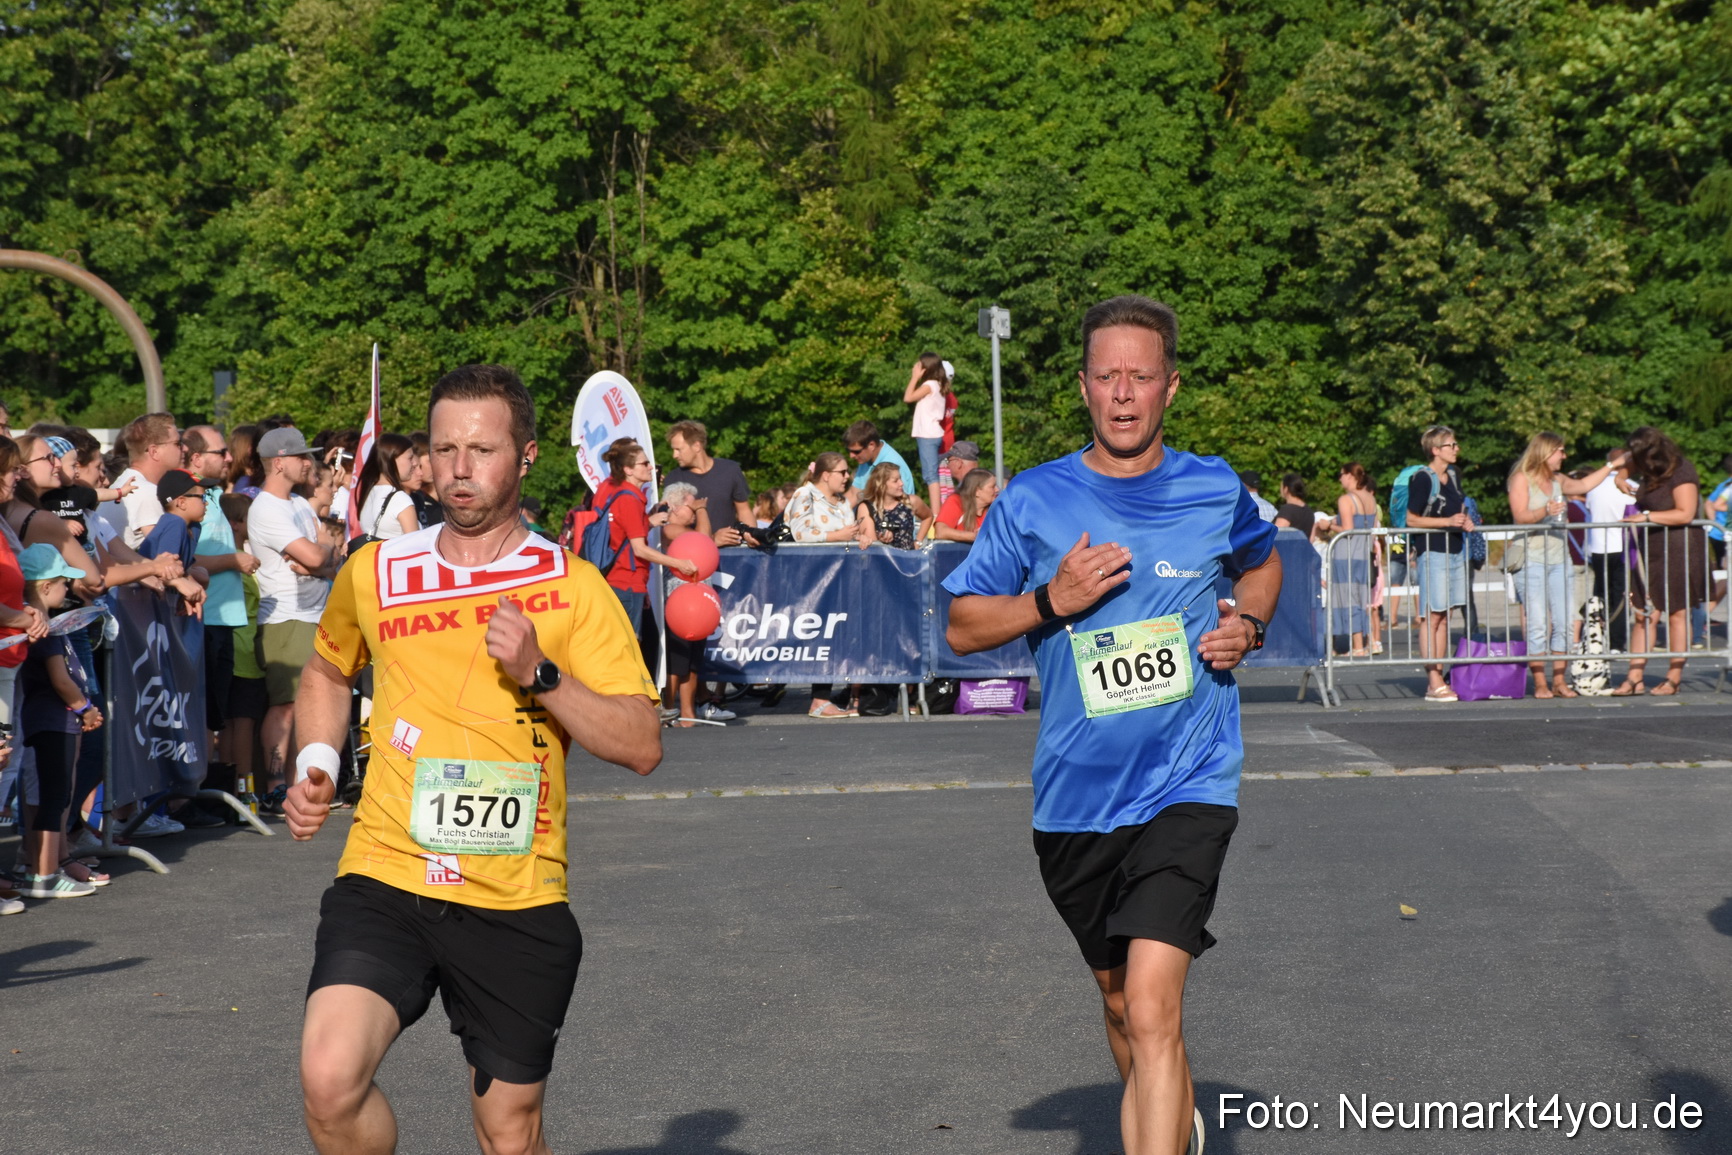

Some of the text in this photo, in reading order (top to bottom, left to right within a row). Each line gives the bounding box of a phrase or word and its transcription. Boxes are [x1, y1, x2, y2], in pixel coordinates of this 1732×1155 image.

[378, 609, 463, 643] MAX
[704, 646, 831, 662] TOMOBILE
[1089, 640, 1133, 656] firmenlauf
[1160, 637, 1179, 647] 2019
[1091, 648, 1177, 691] 1068
[1106, 680, 1171, 700] Göpfert Helmut
[1136, 692, 1156, 701] classic
[433, 777, 483, 788] firmenlauf
[510, 787, 532, 796] 2019
[429, 792, 521, 829] 1570
[437, 828, 510, 839] Fuchs Christian
[444, 837, 460, 845] Bögl
